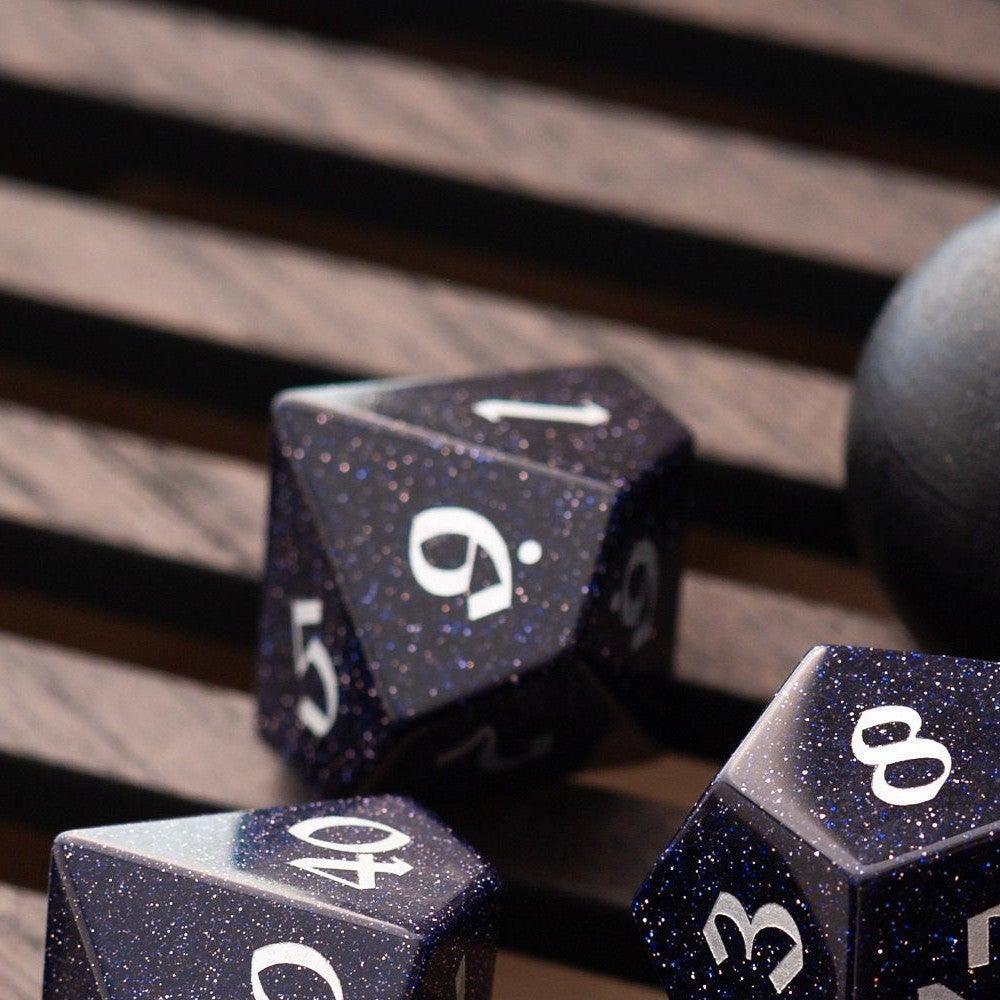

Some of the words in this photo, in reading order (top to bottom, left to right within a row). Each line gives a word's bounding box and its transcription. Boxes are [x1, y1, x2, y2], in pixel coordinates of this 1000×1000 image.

[473, 398, 610, 426] 1
[290, 597, 339, 739] 5
[851, 705, 952, 805] 8
[288, 815, 414, 890] 40
[702, 891, 804, 994] 3
